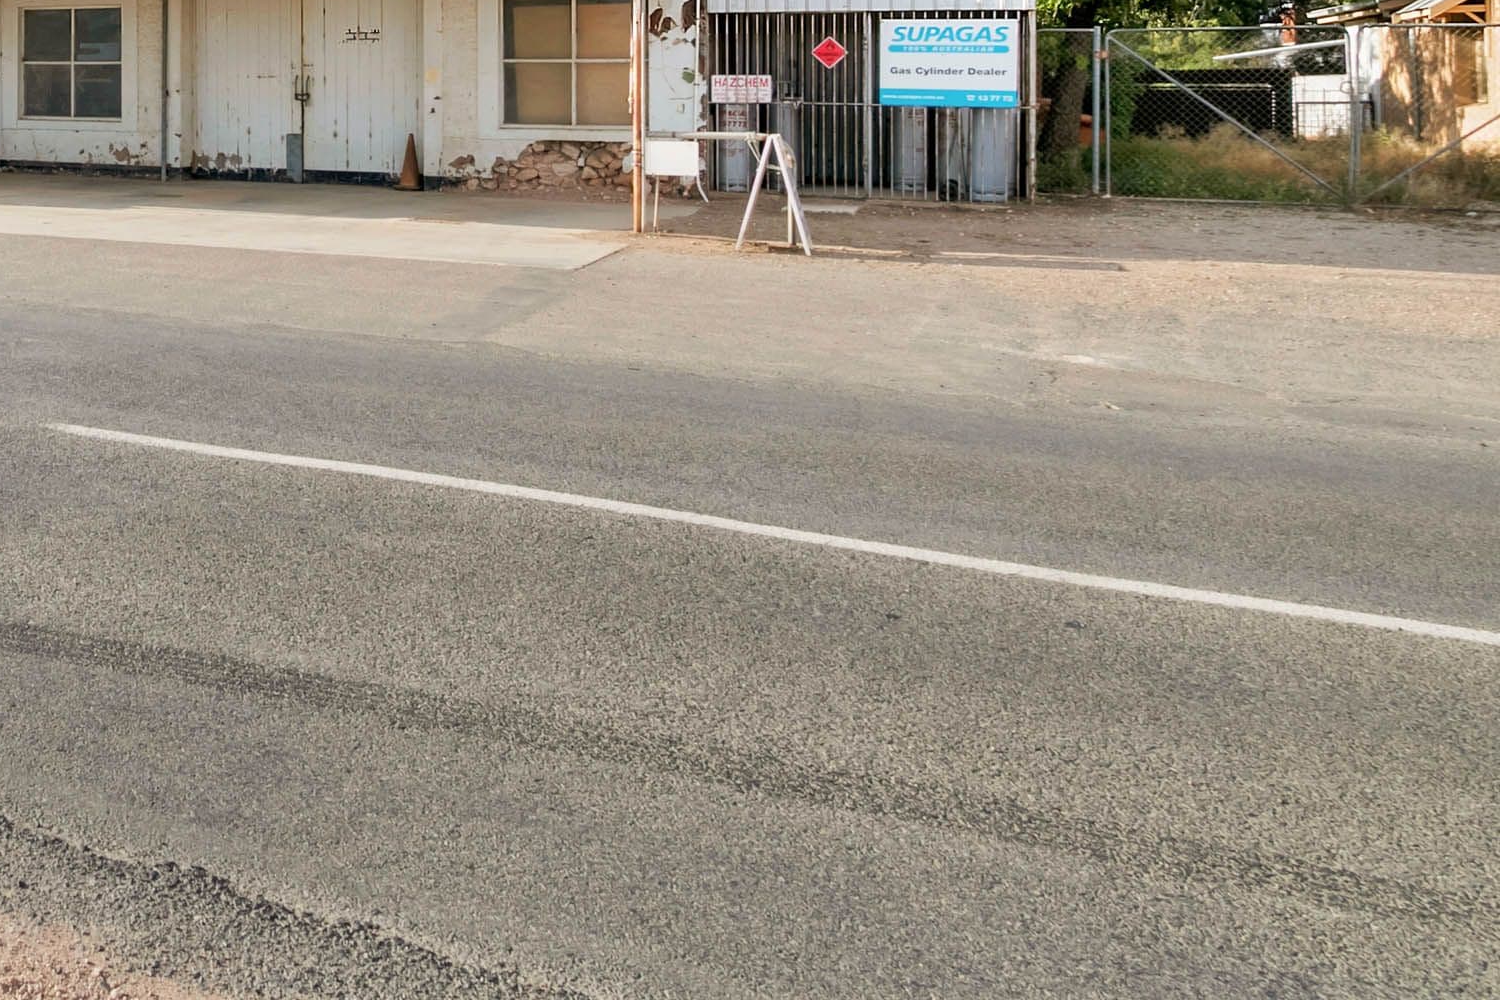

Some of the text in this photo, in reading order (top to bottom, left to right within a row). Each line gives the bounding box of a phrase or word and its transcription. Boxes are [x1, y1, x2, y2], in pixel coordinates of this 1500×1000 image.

[892, 26, 1009, 42] SUPAGAS
[890, 66, 1007, 76] Gas Cylinder Dealer
[714, 77, 769, 88] HAZCHEM
